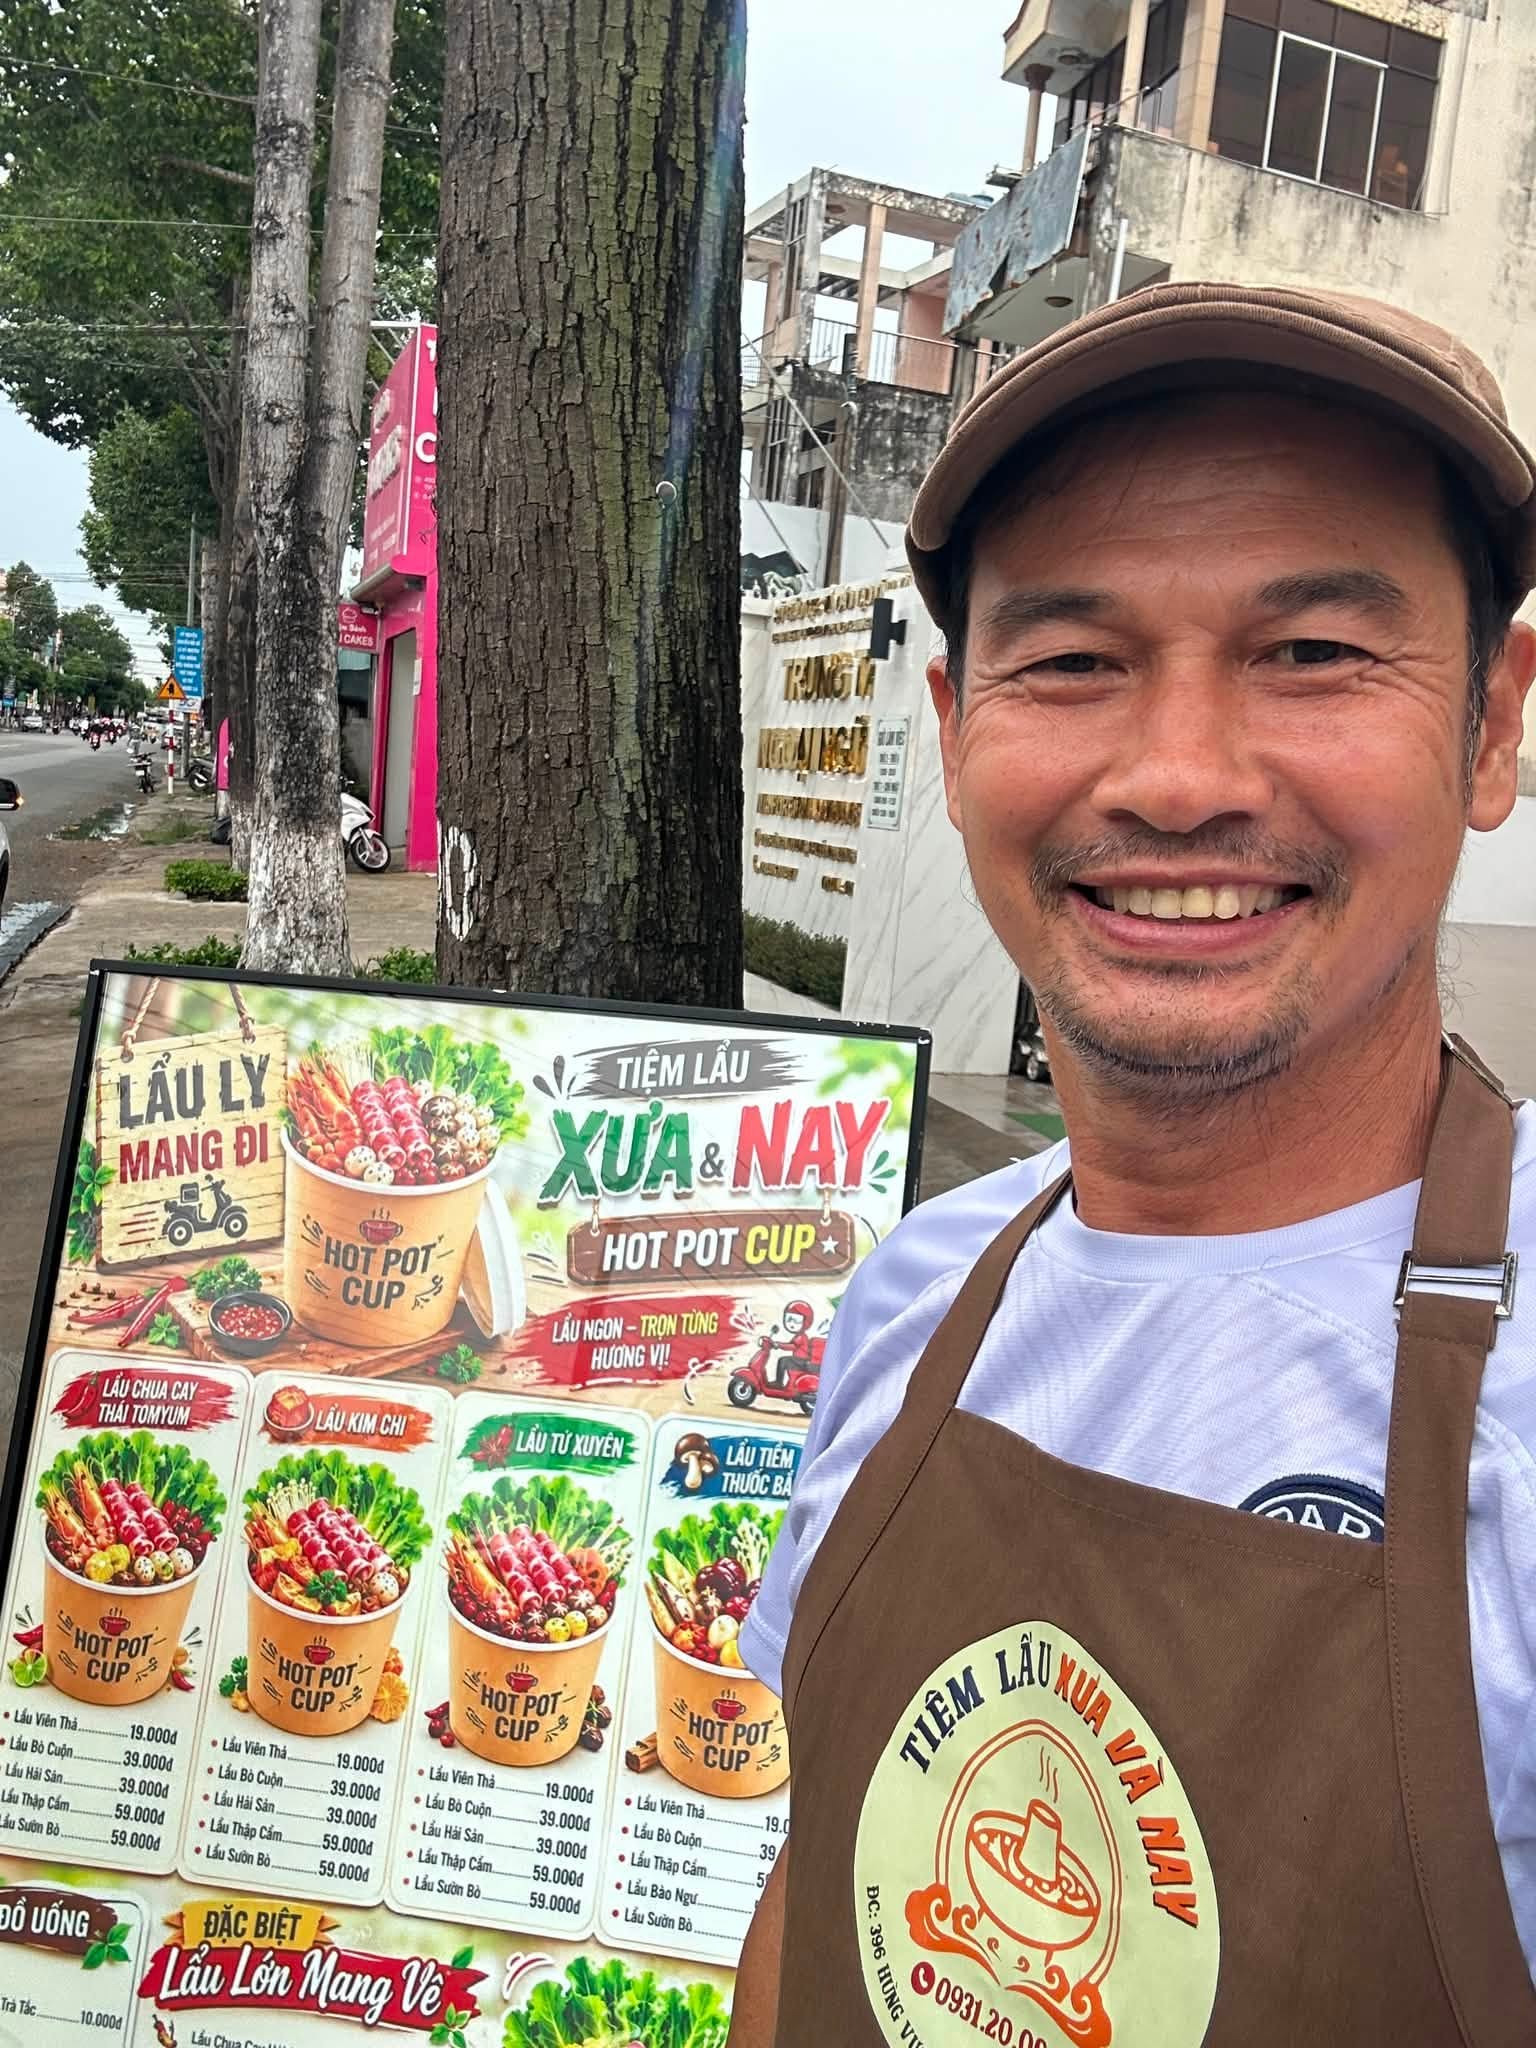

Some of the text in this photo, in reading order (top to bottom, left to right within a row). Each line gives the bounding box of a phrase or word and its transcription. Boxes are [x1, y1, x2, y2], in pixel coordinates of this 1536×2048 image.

[344, 634, 374, 646] CAKES
[616, 1040, 750, 1094] TIỆM LẨU
[119, 1052, 270, 1129] LẨU LY
[119, 1122, 269, 1185] MANG ĐI
[540, 1100, 889, 1202] XƯA & NAY
[324, 1235, 437, 1276] HOT POT
[603, 1224, 816, 1272] HOT POT CUP
[342, 1276, 405, 1309] CUP
[552, 1309, 719, 1343] LẨU NGON TRỌN TỪNG
[591, 1343, 671, 1371] HƯƠNG VỊ!
[102, 1371, 199, 1401] LẨU CHUA CAY
[98, 1399, 191, 1425] THÁI TOMYUM
[315, 1402, 408, 1436] LẨU KIM CHI
[515, 1423, 625, 1459] LẨU TỨ XUYÊN
[725, 1438, 757, 1467] LẨU
[722, 1467, 793, 1496] THUỐC BẮ
[75, 1628, 153, 1659] HOT POT
[87, 1660, 130, 1683] CUP
[279, 1656, 357, 1689] HOT POT
[291, 1688, 335, 1712] CUP
[481, 1683, 563, 1716] HOT POT
[36, 1712, 57, 1728] Viên
[130, 1724, 178, 1745] 19.000đ
[495, 1716, 540, 1741] CUP
[689, 1711, 773, 1746] HOT POT
[31, 1739, 44, 1754] Bò
[47, 1742, 73, 1760] Cuộn
[123, 1751, 174, 1772] 39.000đ
[245, 1741, 266, 1757] Viên
[337, 1753, 384, 1774] 19.000đ
[704, 1745, 751, 1772] CUP
[119, 1777, 170, 1799] 39.000đ
[240, 1768, 254, 1783] Bò
[257, 1771, 283, 1788] Cuộn
[330, 1780, 381, 1801] 39.000đ
[452, 1769, 473, 1785] Viên
[545, 1782, 594, 1804] 19.000đ
[900, 1665, 985, 1774] TIỆM
[1054, 1653, 1112, 1738] XƯA
[1104, 1728, 1164, 1804] VÀ
[1136, 1816, 1199, 1928] NAY
[22, 1792, 45, 1811] Thập
[115, 1804, 165, 1825] 59.000đ
[326, 1807, 377, 1829] 39.000đ
[448, 1797, 462, 1813] Bò
[465, 1800, 492, 1819] Cuộn
[539, 1810, 591, 1832] 39.000đ
[660, 1799, 682, 1815] Viên
[765, 1815, 790, 1834] 19.0
[46, 1821, 60, 1836] Bò
[111, 1829, 161, 1852] 59.000đ
[232, 1821, 256, 1840] Thập
[322, 1833, 373, 1856] 59.000đ
[535, 1837, 587, 1859] 39.000đ
[657, 1827, 671, 1843] Bò
[674, 1830, 702, 1850] Cuộn
[759, 1844, 777, 1861] 39
[257, 1851, 271, 1867] Bò
[318, 1860, 370, 1882] 59.000đ
[441, 1851, 466, 1871] Thập
[532, 1865, 584, 1887] 59.000đ
[654, 1855, 679, 1875] Thập
[467, 1883, 481, 1899] Bò
[529, 1892, 581, 1914] 59.000đ
[0, 1896, 90, 1937] ĐỒ UỐNG
[203, 1904, 303, 1947] ĐẶC BIỆT
[678, 1917, 693, 1932] Bò
[867, 1885, 905, 2023] ĐC: 396 HÙNG
[160, 1944, 445, 2026] Lẩu Lớn Mang Về
[80, 2010, 123, 2030] 10.000đ
